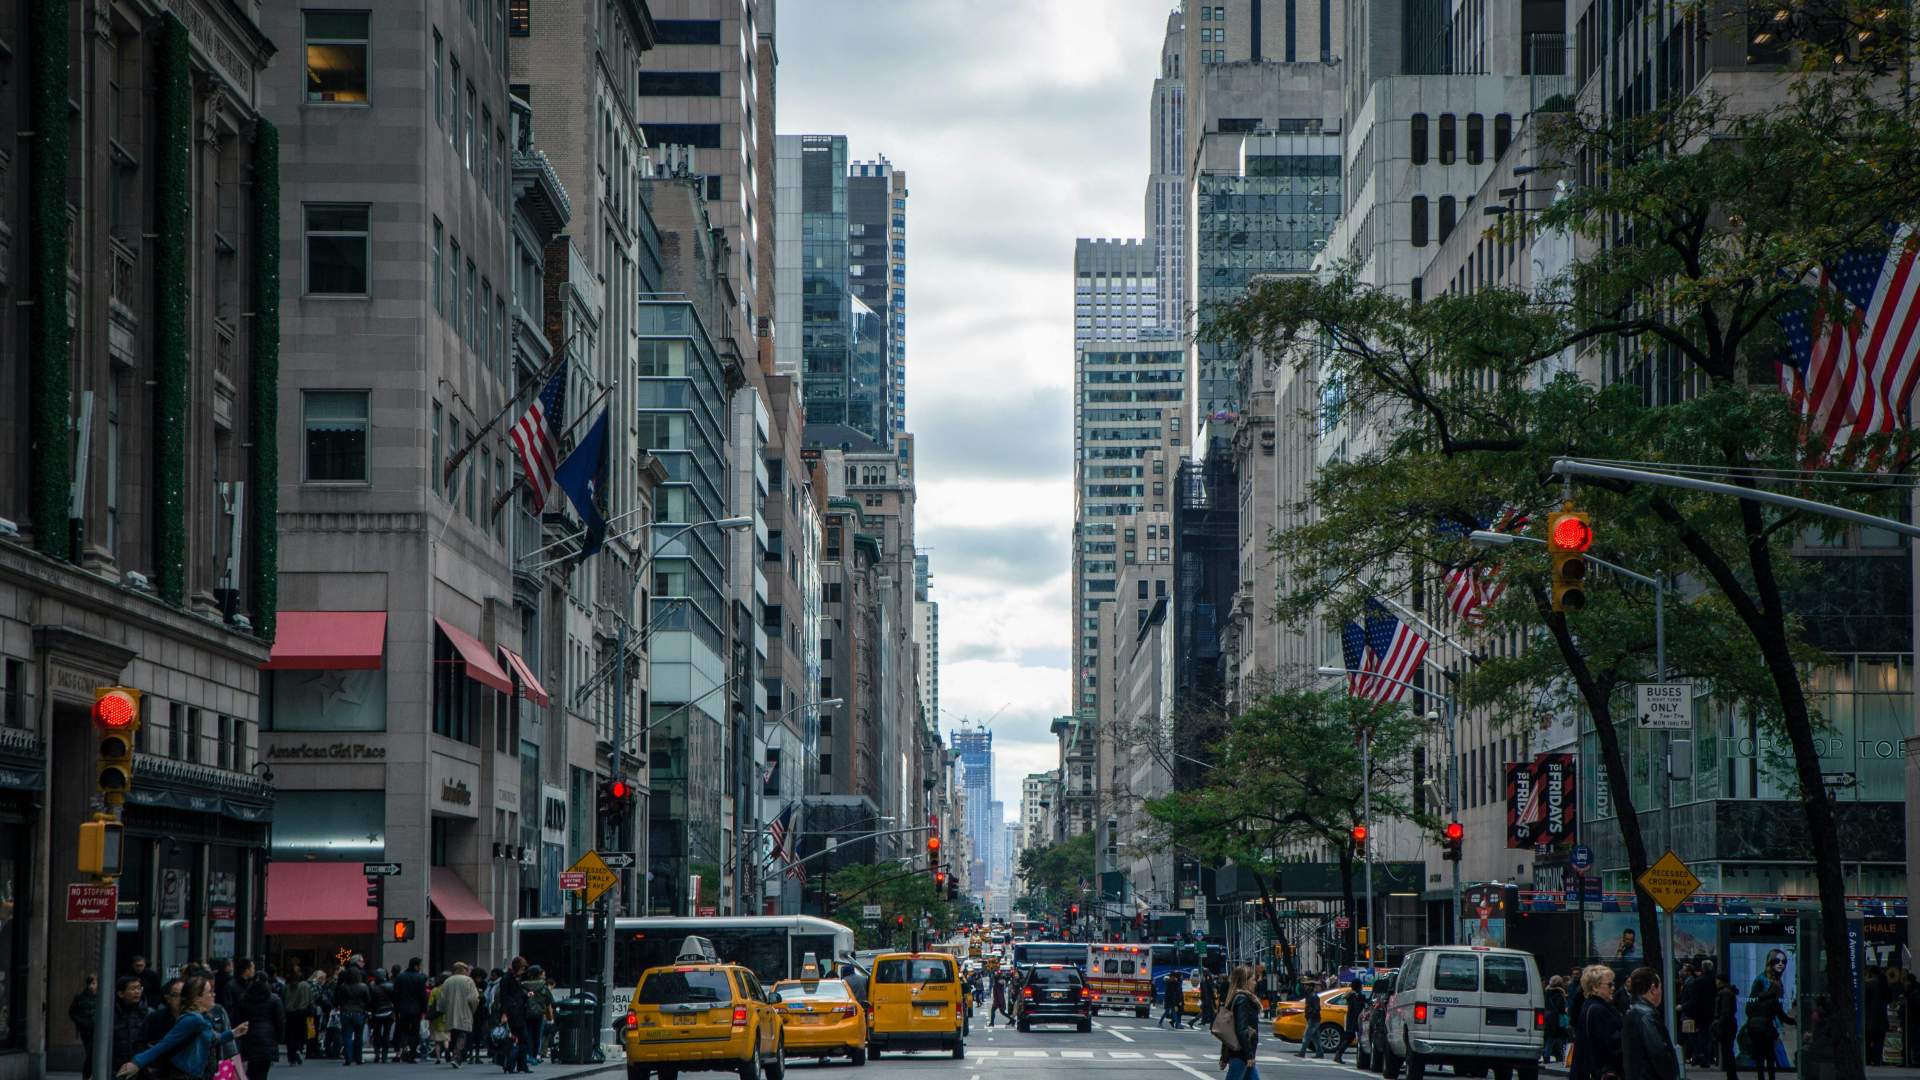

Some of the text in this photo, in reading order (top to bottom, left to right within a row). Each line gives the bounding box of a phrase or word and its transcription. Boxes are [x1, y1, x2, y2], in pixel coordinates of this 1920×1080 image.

[1647, 687, 1682, 696] BUSES
[1651, 703, 1678, 712] ONLY
[267, 743, 386, 758] American Girl Place
[1720, 737, 1844, 757] TOPSOP
[1549, 763, 1562, 771] TGI
[1549, 771, 1562, 833] FRIDAYS
[1651, 869, 1689, 878] RECESSED
[1648, 878, 1692, 886] CROSSWALK
[71, 887, 115, 896] NO STOPPING
[1674, 887, 1688, 895] AVE
[76, 897, 109, 906] ANYTIME
